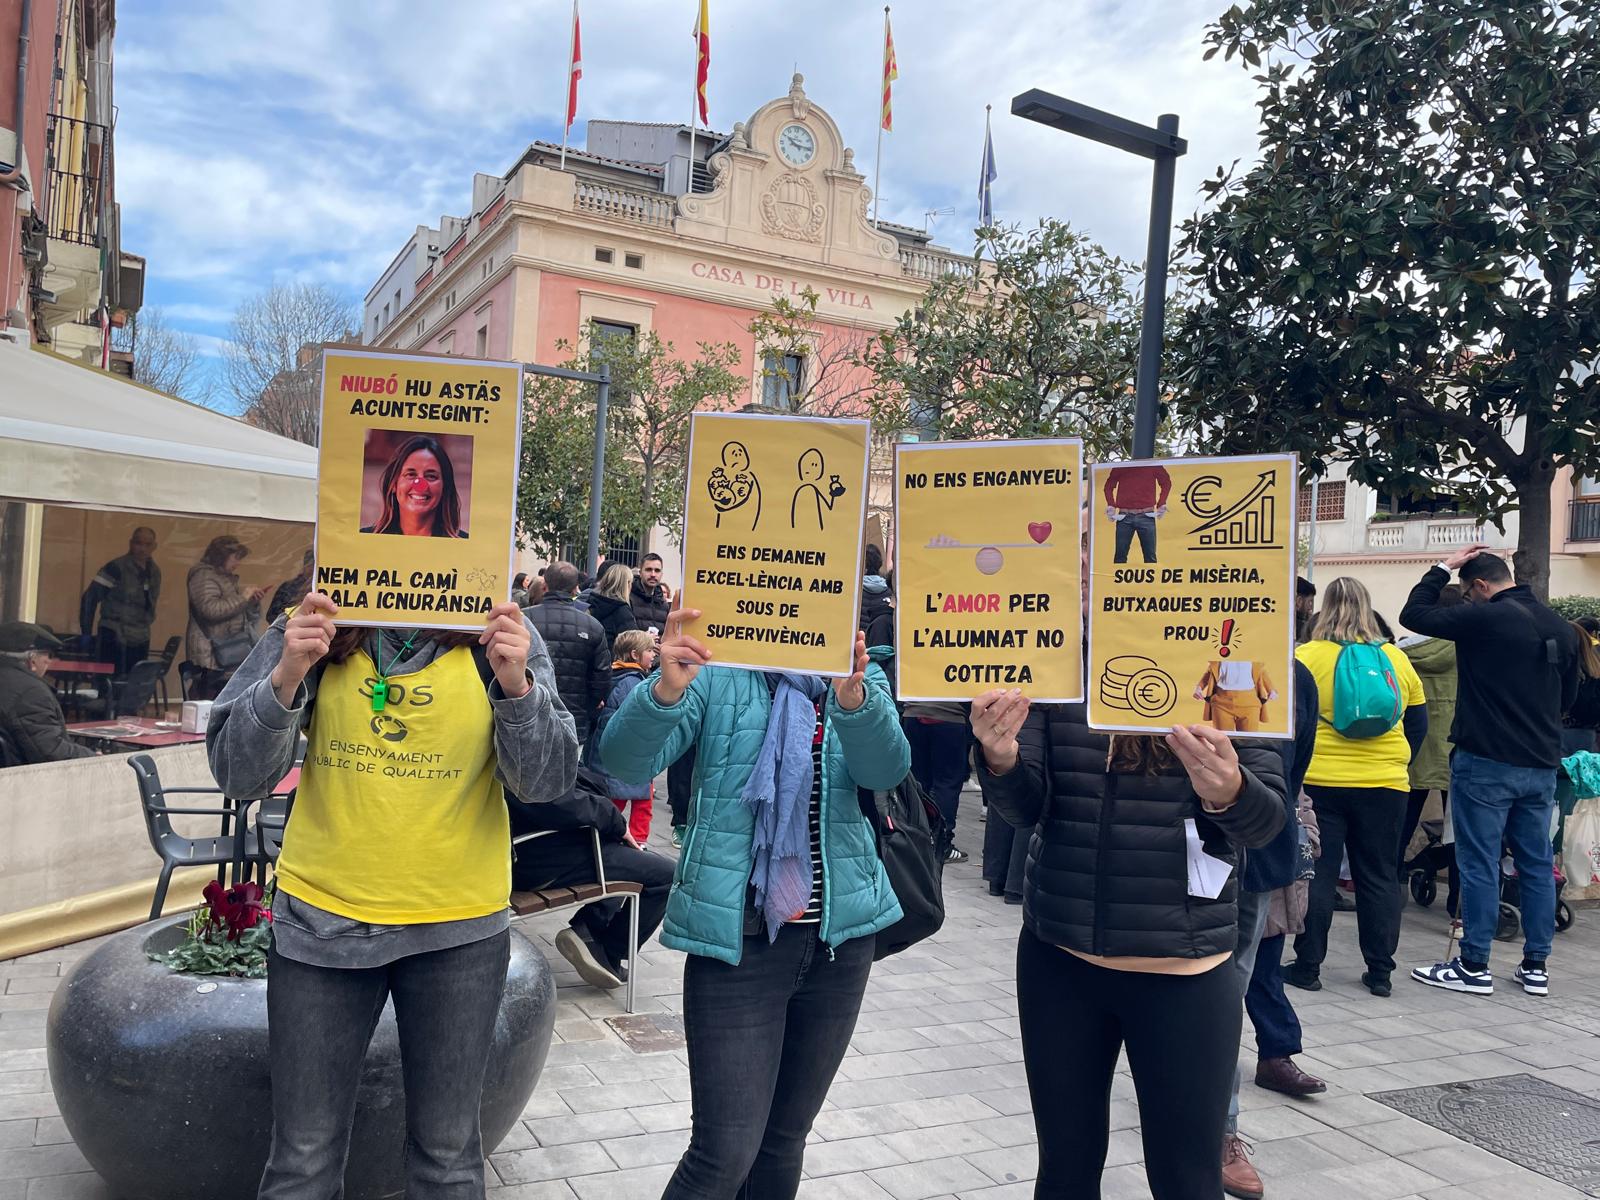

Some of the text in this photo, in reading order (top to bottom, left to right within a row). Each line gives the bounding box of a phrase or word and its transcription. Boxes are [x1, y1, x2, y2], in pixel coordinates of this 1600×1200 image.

[691, 262, 745, 286] CASA
[755, 274, 784, 293] DE
[826, 287, 873, 310] VILA
[341, 374, 501, 402] NIUBÓ HU ASTÄS
[350, 399, 490, 424] ACUNTSEGINT:
[905, 469, 1072, 489] NO ENS ENGANYEU:
[716, 544, 826, 566] ENS DEMANEN
[317, 566, 458, 591] NEM PAL CAMÌ
[1113, 564, 1265, 585] SOUS DE MISÈRIA,
[808, 578, 844, 595] AMB
[376, 590, 493, 614] ICNURÁNSIA
[736, 599, 800, 618] SOUS DE
[1008, 593, 1051, 613] PER
[1103, 597, 1276, 613] BUTXAQUES BUIDES:
[706, 623, 826, 648] SUPERVIVÈNCIA
[913, 628, 1065, 648] L'ALUMNAT NO
[944, 664, 1033, 684] COTITZA
[329, 739, 444, 764] ENSENYAMENT
[356, 761, 376, 774] DE
[382, 765, 462, 779] QUALITAT
